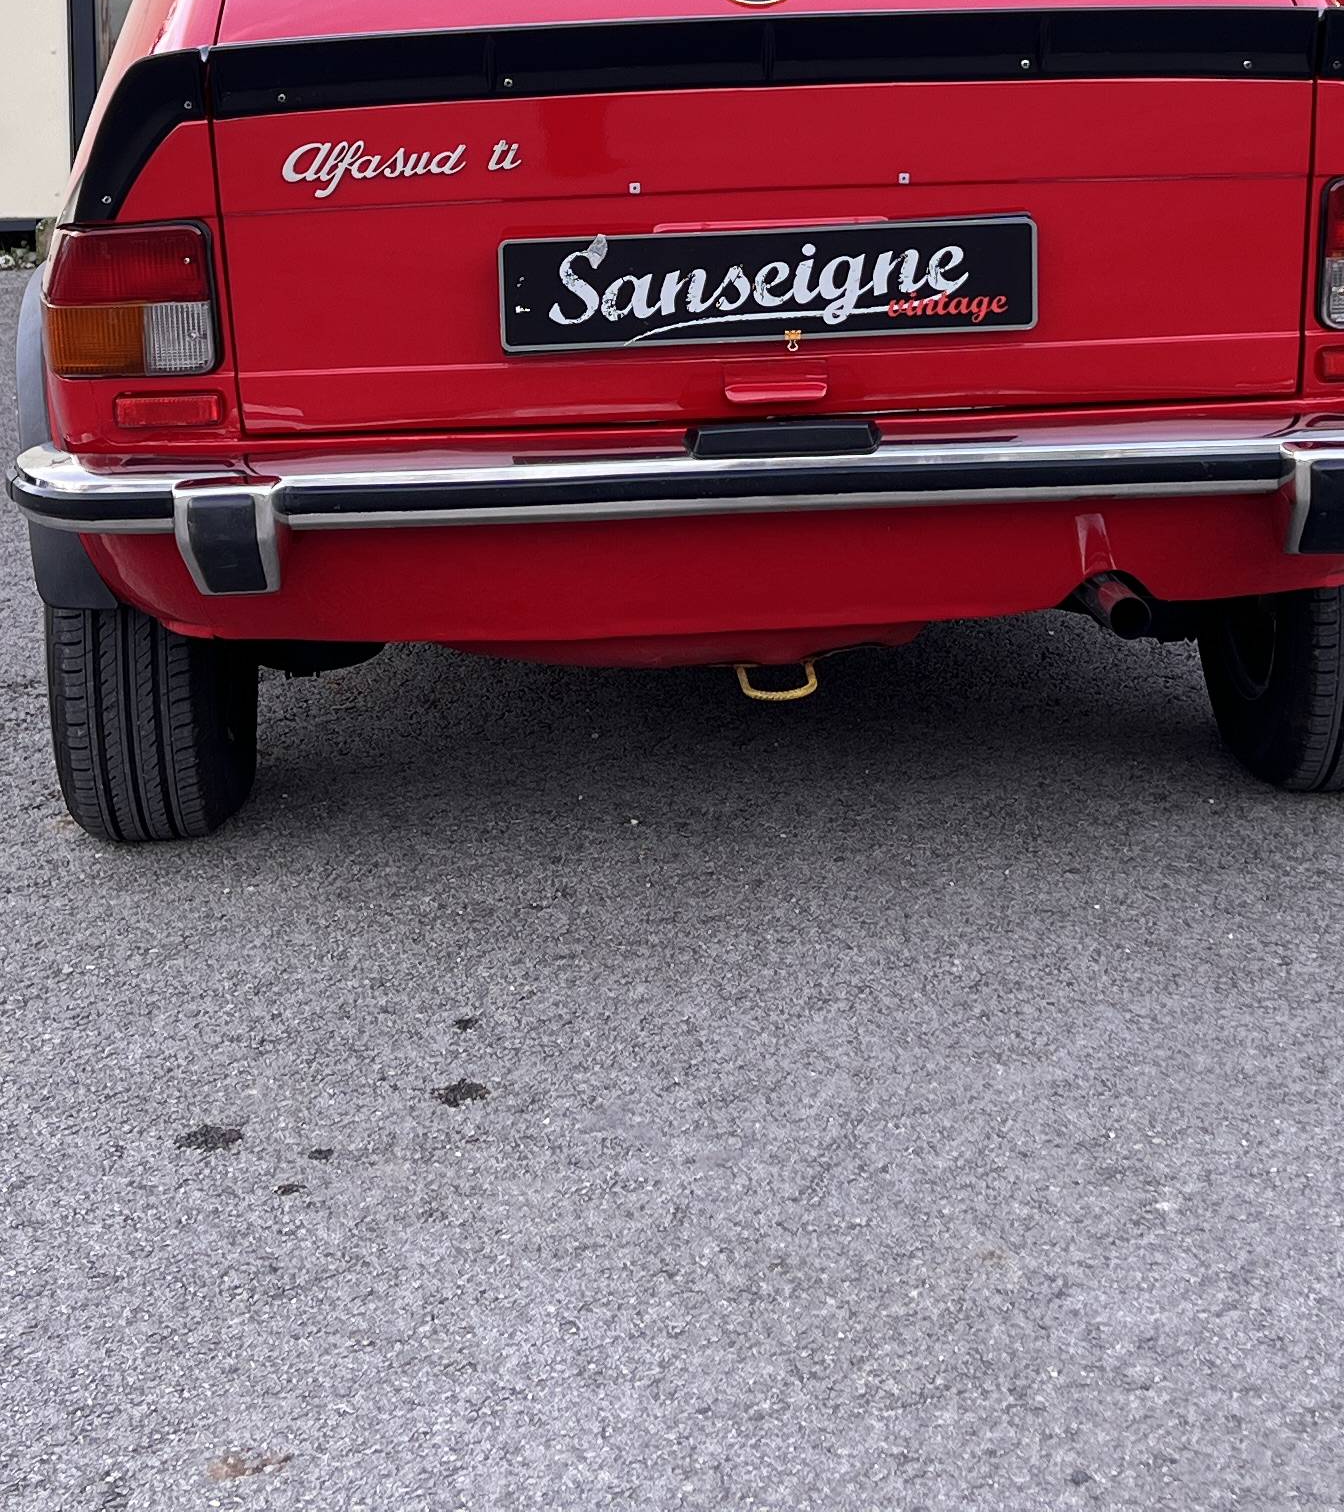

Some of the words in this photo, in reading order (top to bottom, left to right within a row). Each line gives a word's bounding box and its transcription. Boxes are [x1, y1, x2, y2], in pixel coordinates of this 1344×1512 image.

[281, 139, 467, 198] Alfasud
[487, 138, 522, 171] ti
[548, 233, 970, 326] Sanseigne
[886, 289, 1008, 323] vintage
